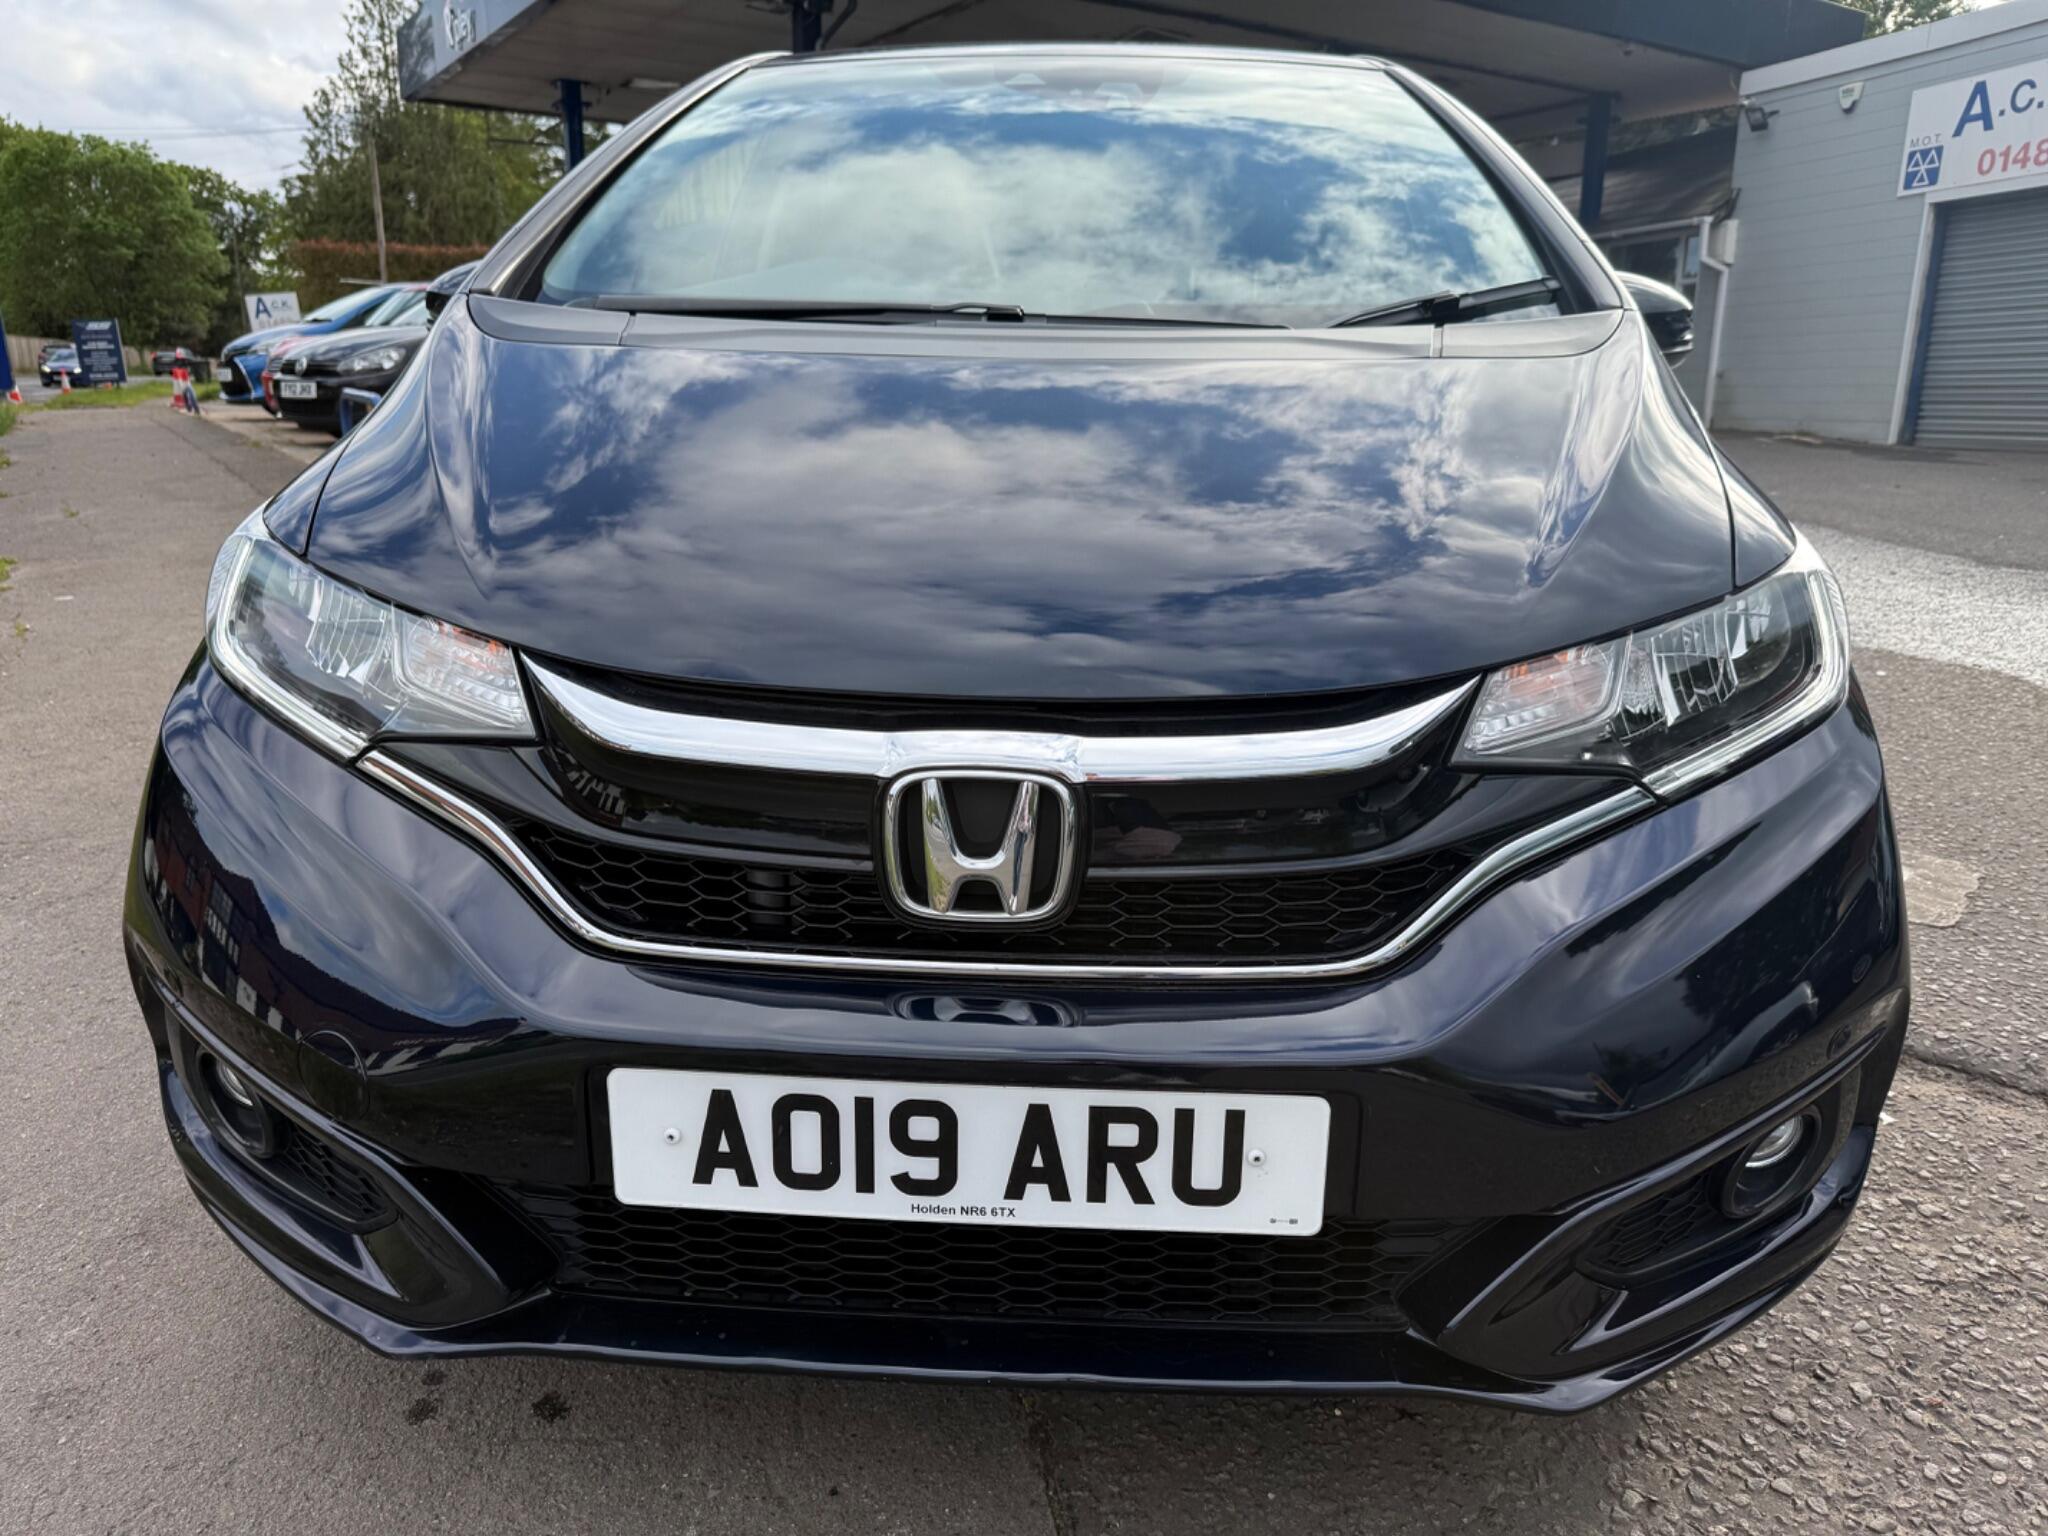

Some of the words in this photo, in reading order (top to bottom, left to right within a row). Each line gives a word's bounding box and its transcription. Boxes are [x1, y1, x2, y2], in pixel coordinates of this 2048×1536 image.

[1003, 1103, 1246, 1207] ARU
[911, 1203, 956, 1215] Holden
[960, 1206, 987, 1217] NR6
[990, 1207, 1016, 1218] 6TX
